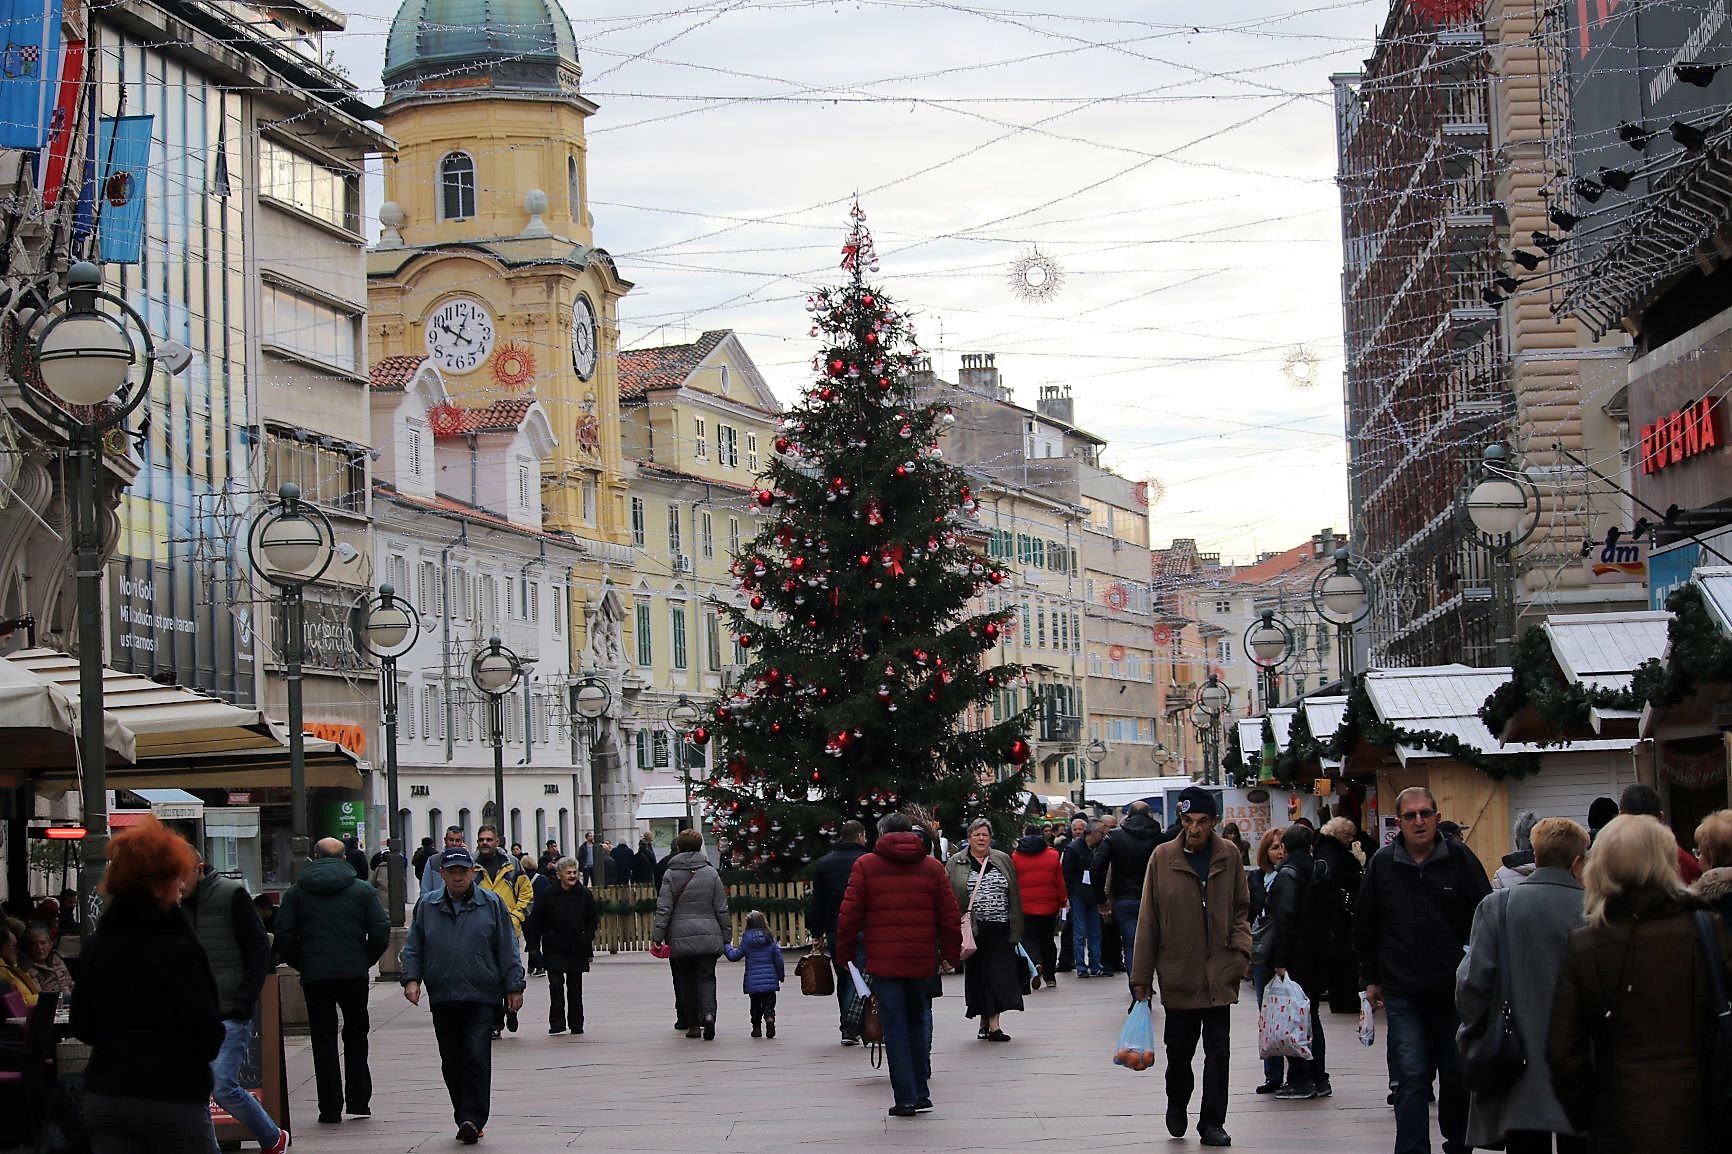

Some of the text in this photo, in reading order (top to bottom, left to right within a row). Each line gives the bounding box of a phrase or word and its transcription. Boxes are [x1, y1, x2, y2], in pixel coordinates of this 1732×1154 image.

[445, 306, 452, 320] 11
[456, 303, 466, 317] 12
[472, 306, 475, 320] 1
[433, 314, 444, 328] 10
[477, 313, 484, 326] 2
[429, 330, 437, 344] 9
[483, 327, 491, 341] 3
[434, 344, 443, 359] 8
[478, 341, 485, 354] 4
[446, 353, 453, 367] 7
[456, 355, 465, 369] 6
[468, 352, 476, 366] 5
[1640, 396, 1718, 475] ROBNA
[1601, 545, 1639, 563] dm
[119, 575, 137, 597] Noi
[411, 785, 430, 797] ZARA
[544, 784, 559, 795] ZARA
